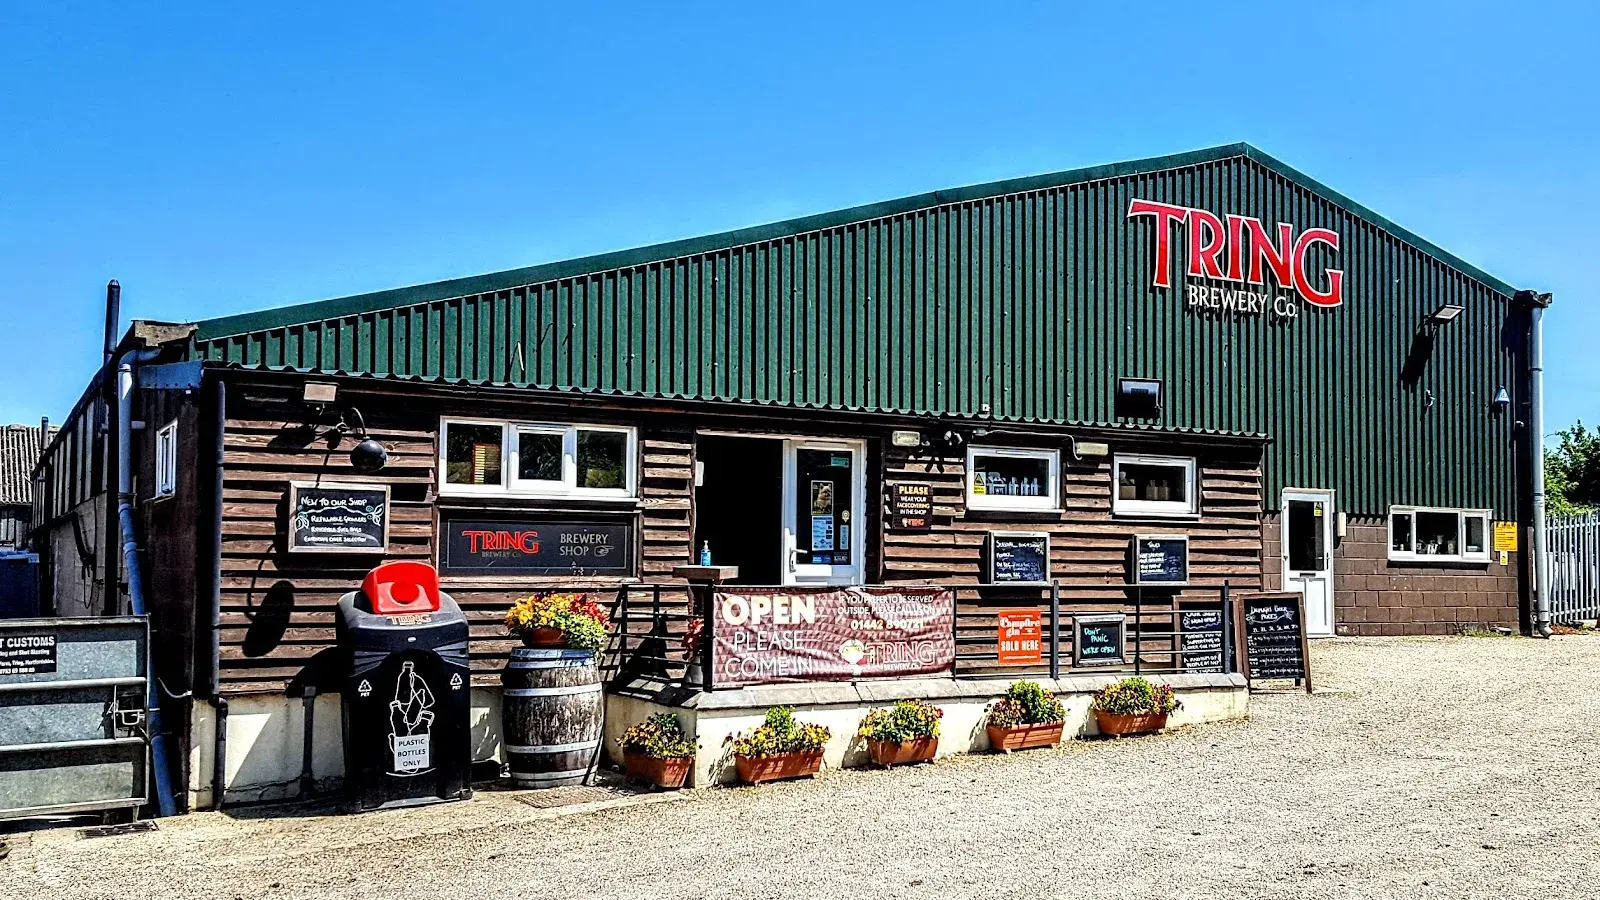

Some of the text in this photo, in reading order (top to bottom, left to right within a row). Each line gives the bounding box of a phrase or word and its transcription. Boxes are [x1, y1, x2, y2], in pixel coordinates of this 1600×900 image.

[1127, 198, 1344, 308] TRING
[1188, 284, 1268, 314] BREWERY
[899, 486, 928, 495] PLEASE
[301, 496, 318, 506] NEW
[319, 498, 329, 506] TO
[348, 498, 367, 507] SHOP
[462, 531, 608, 554] TRING BREWERY
[559, 545, 589, 557] SHOP
[864, 595, 887, 604] PREFER
[888, 595, 898, 603] TO
[907, 595, 934, 603] SERVED
[722, 596, 815, 626] OPEN
[871, 606, 896, 615] PLEASE
[896, 606, 912, 614] CALL
[913, 606, 922, 614] US
[923, 605, 935, 615] ON
[851, 619, 924, 630] 01442 890721
[1000, 617, 1040, 630] Campfire
[1006, 627, 1020, 638] gin
[7, 636, 55, 648] CUSTOMS
[734, 630, 804, 652] PLEASE
[1001, 640, 1039, 651] SOLD HERE
[865, 641, 938, 666] TRING
[725, 655, 813, 678] COME IN
[884, 662, 909, 671] BREWERY
[398, 738, 425, 746] PLASTIC
[397, 749, 426, 757] BOTTLES
